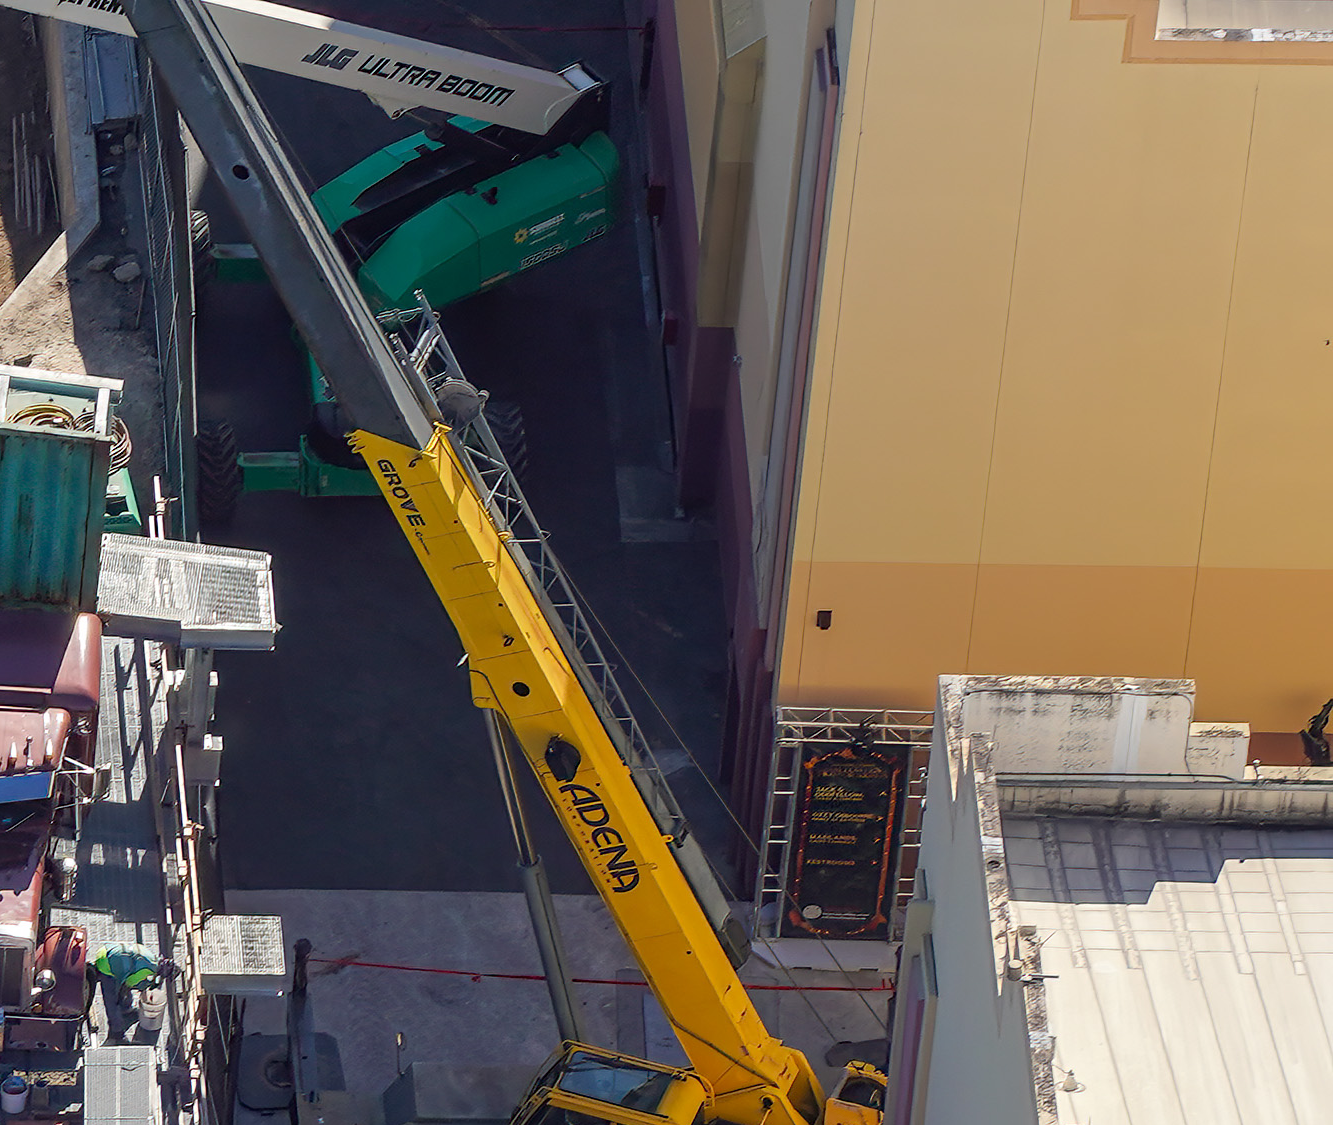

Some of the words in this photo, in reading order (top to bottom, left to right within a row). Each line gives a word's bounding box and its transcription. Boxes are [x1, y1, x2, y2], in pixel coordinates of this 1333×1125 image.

[301, 43, 360, 71] JLG
[357, 54, 442, 88] ULTRA
[435, 74, 516, 107] BOOM
[377, 459, 426, 527] GROVE
[558, 783, 640, 893] ADENA
